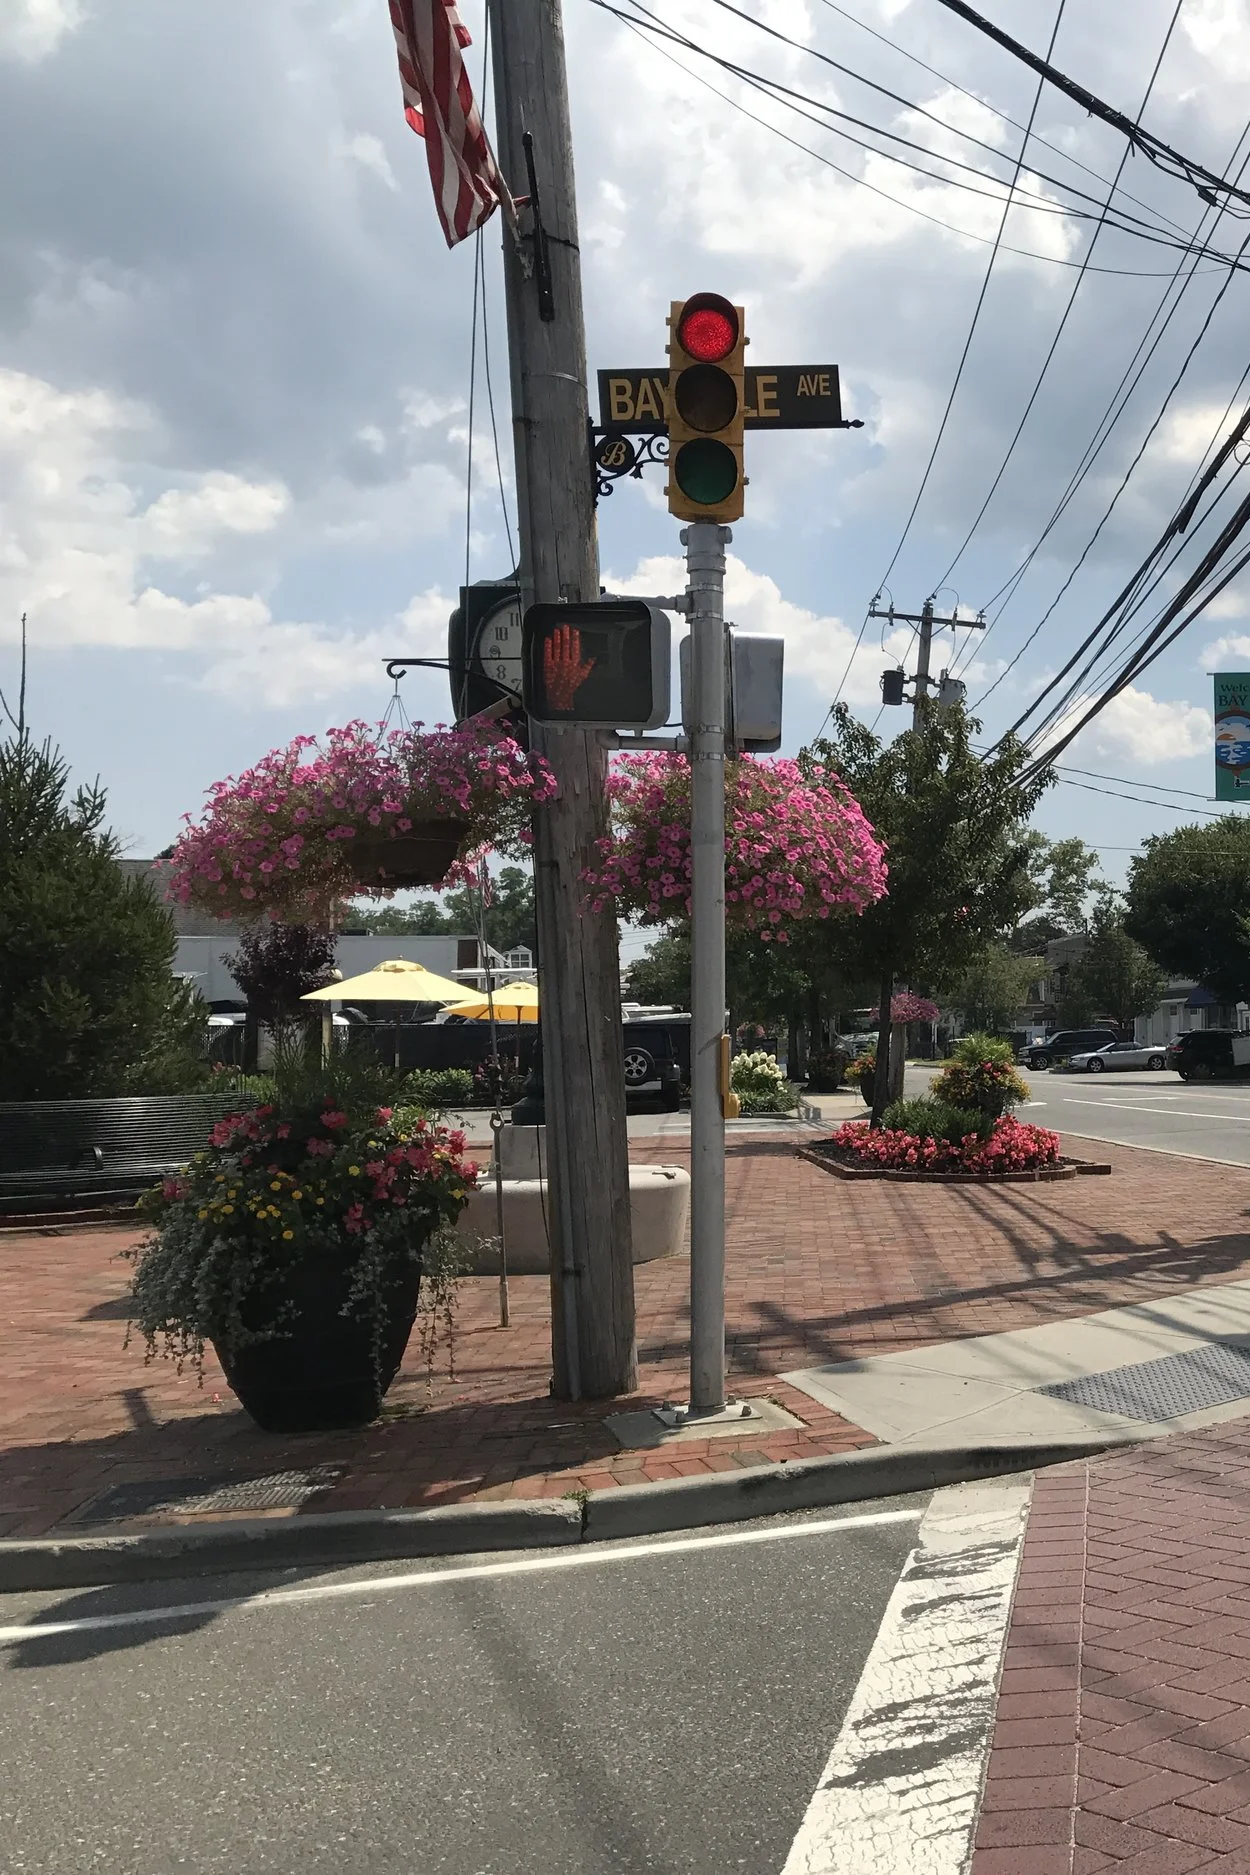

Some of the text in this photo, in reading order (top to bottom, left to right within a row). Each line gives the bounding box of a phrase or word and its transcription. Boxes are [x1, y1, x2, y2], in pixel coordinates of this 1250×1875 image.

[608, 374, 832, 421] BAYE AVE
[600, 440, 627, 467] B
[496, 664, 506, 680] 8
[510, 678, 522, 693] 7
